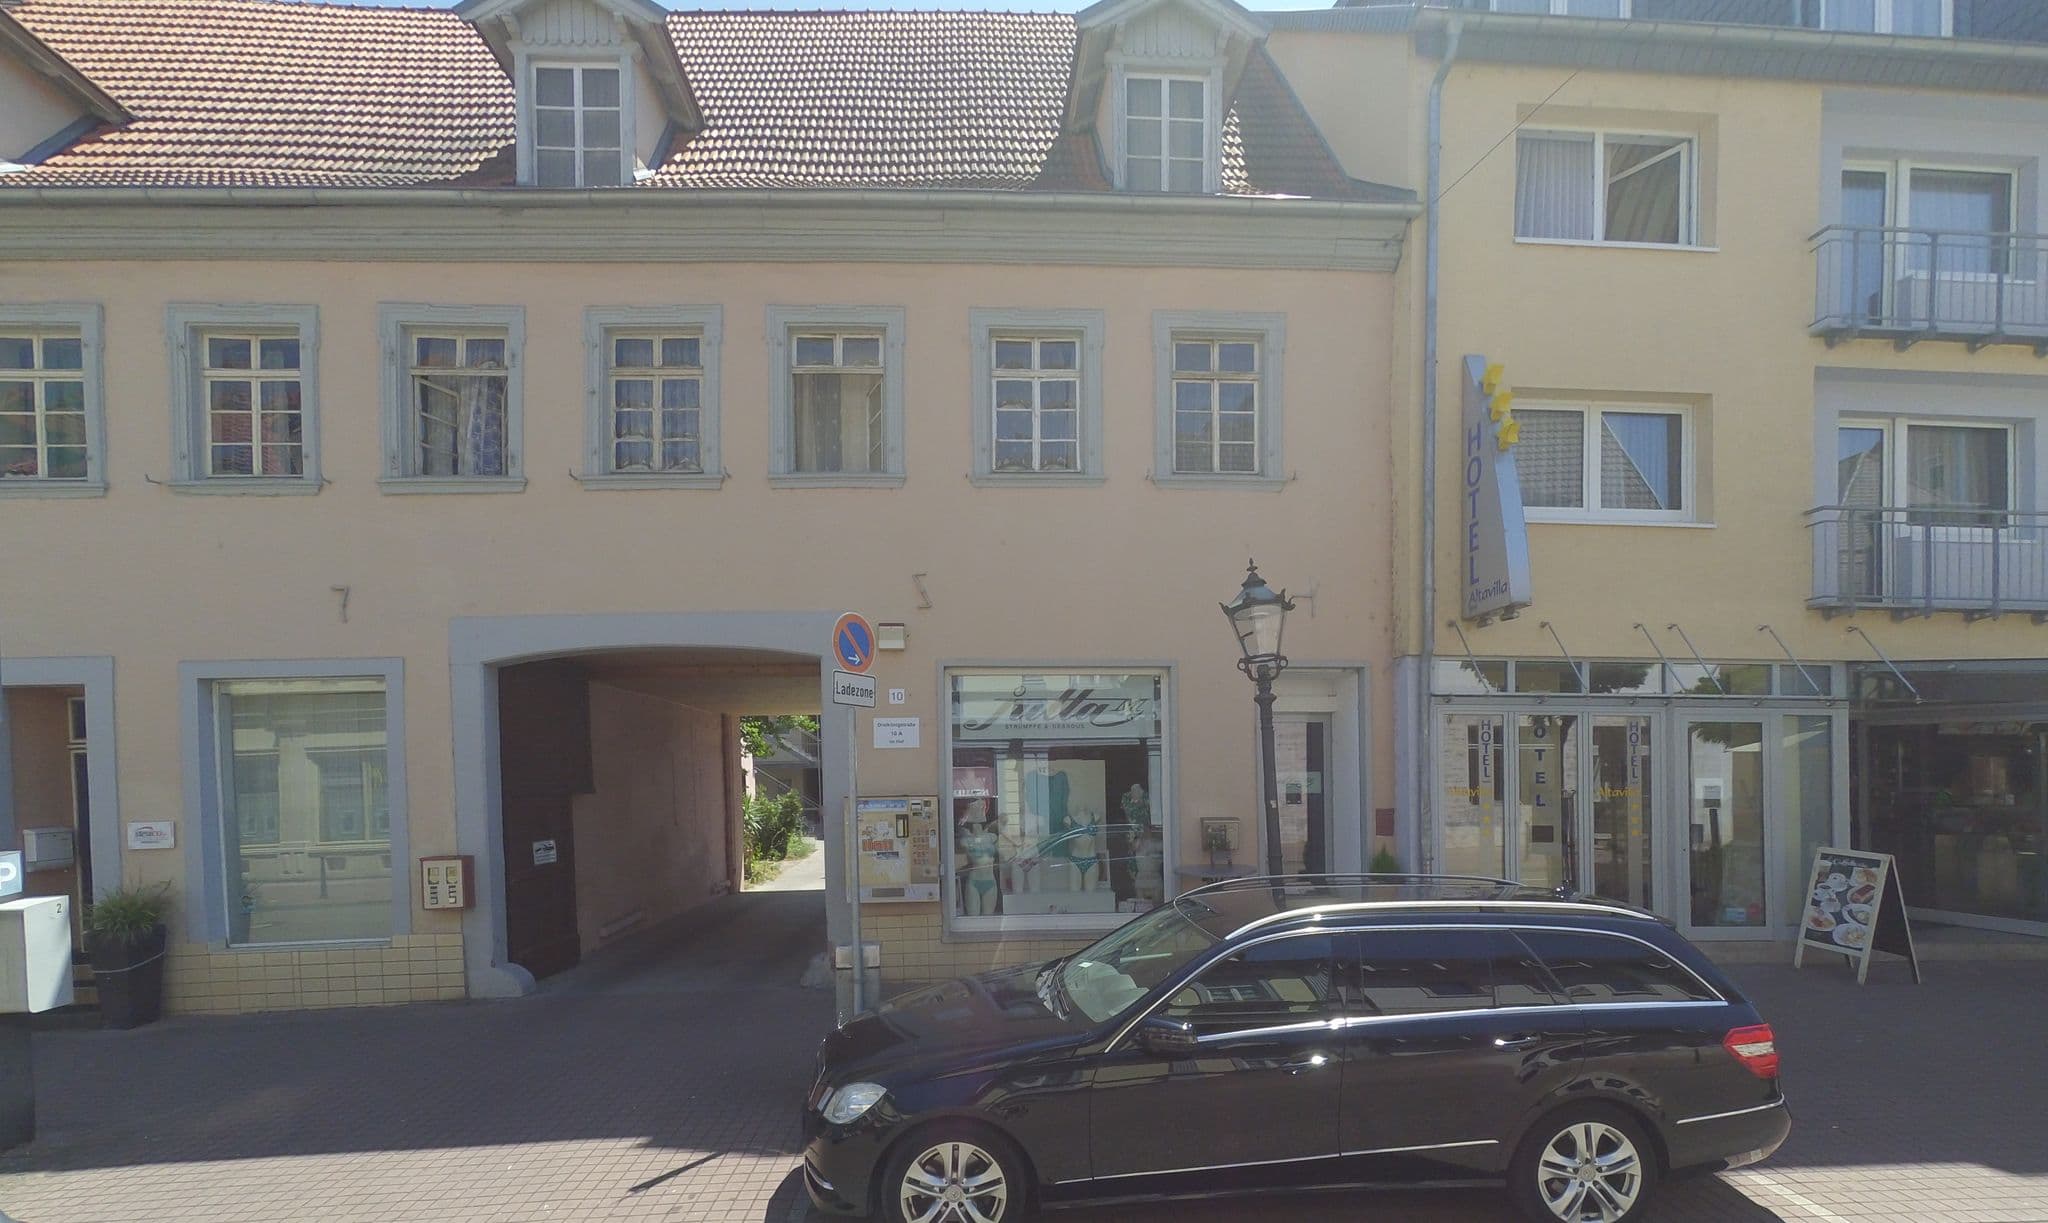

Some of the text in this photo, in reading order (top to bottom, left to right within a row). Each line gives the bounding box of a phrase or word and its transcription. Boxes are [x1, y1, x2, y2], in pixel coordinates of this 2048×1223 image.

[1467, 421, 1483, 585] HOTEL
[835, 680, 874, 699] Ladezone
[891, 691, 903, 701] 10
[1480, 719, 1492, 778] HOTEL
[1629, 721, 1640, 779] HOTEL
[56, 903, 62, 914] 2
